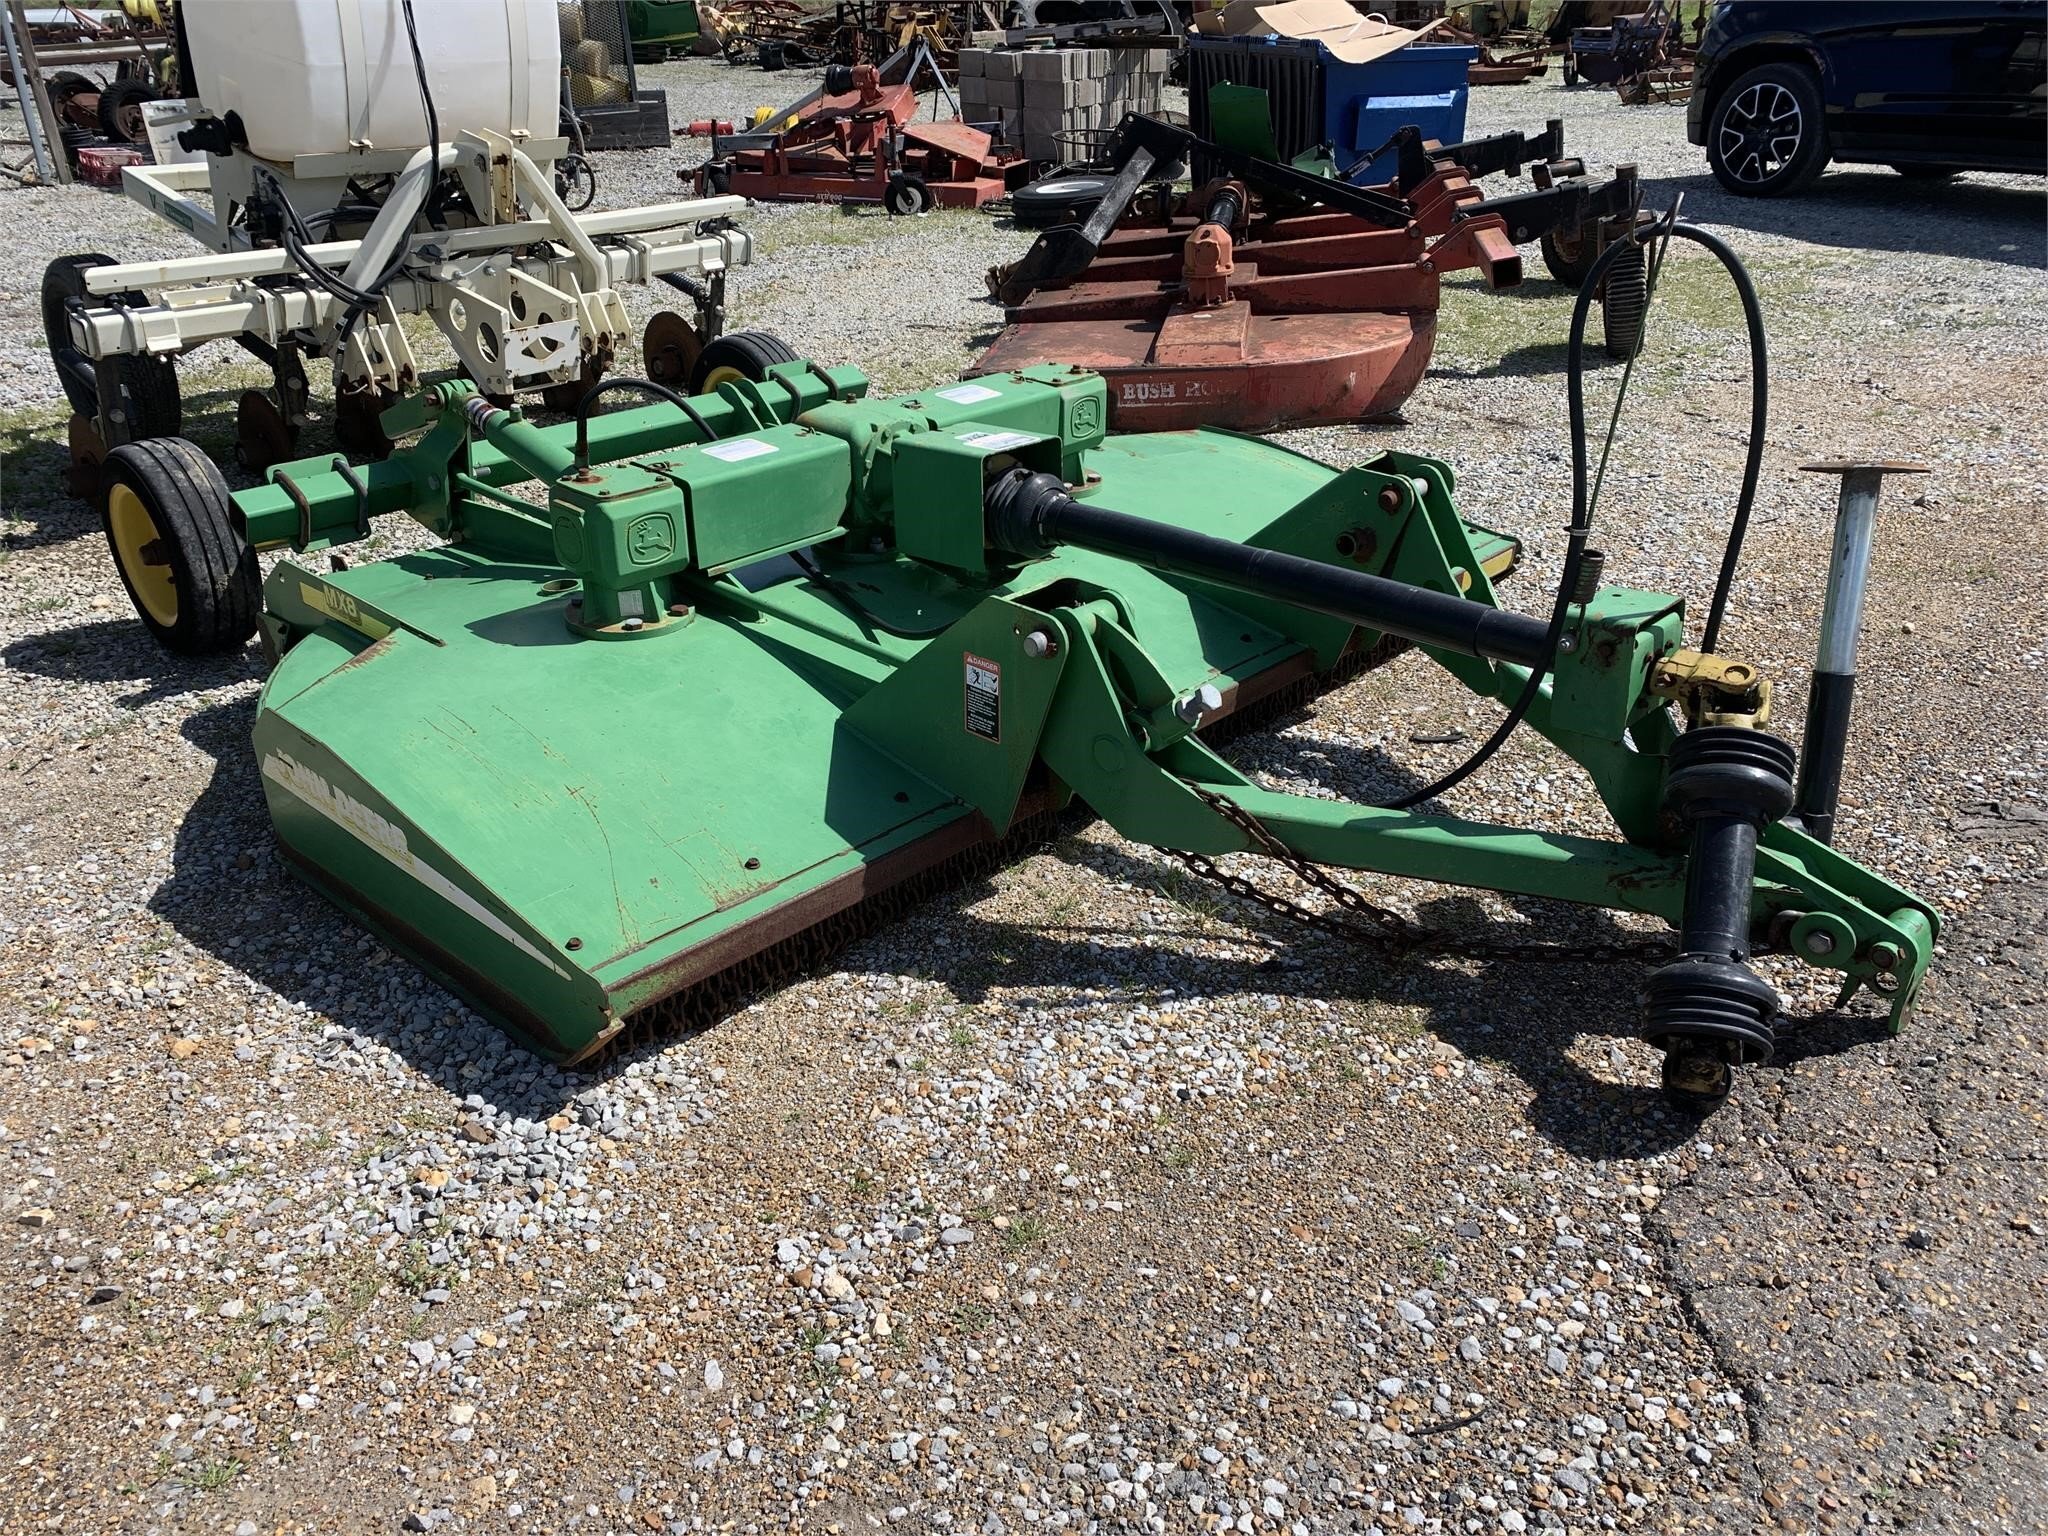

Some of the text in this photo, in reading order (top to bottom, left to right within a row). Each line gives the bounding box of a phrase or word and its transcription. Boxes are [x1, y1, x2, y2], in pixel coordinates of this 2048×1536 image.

[1123, 380, 1225, 399] BUSH HO
[322, 584, 357, 618] MX8
[973, 658, 999, 672] DANGER
